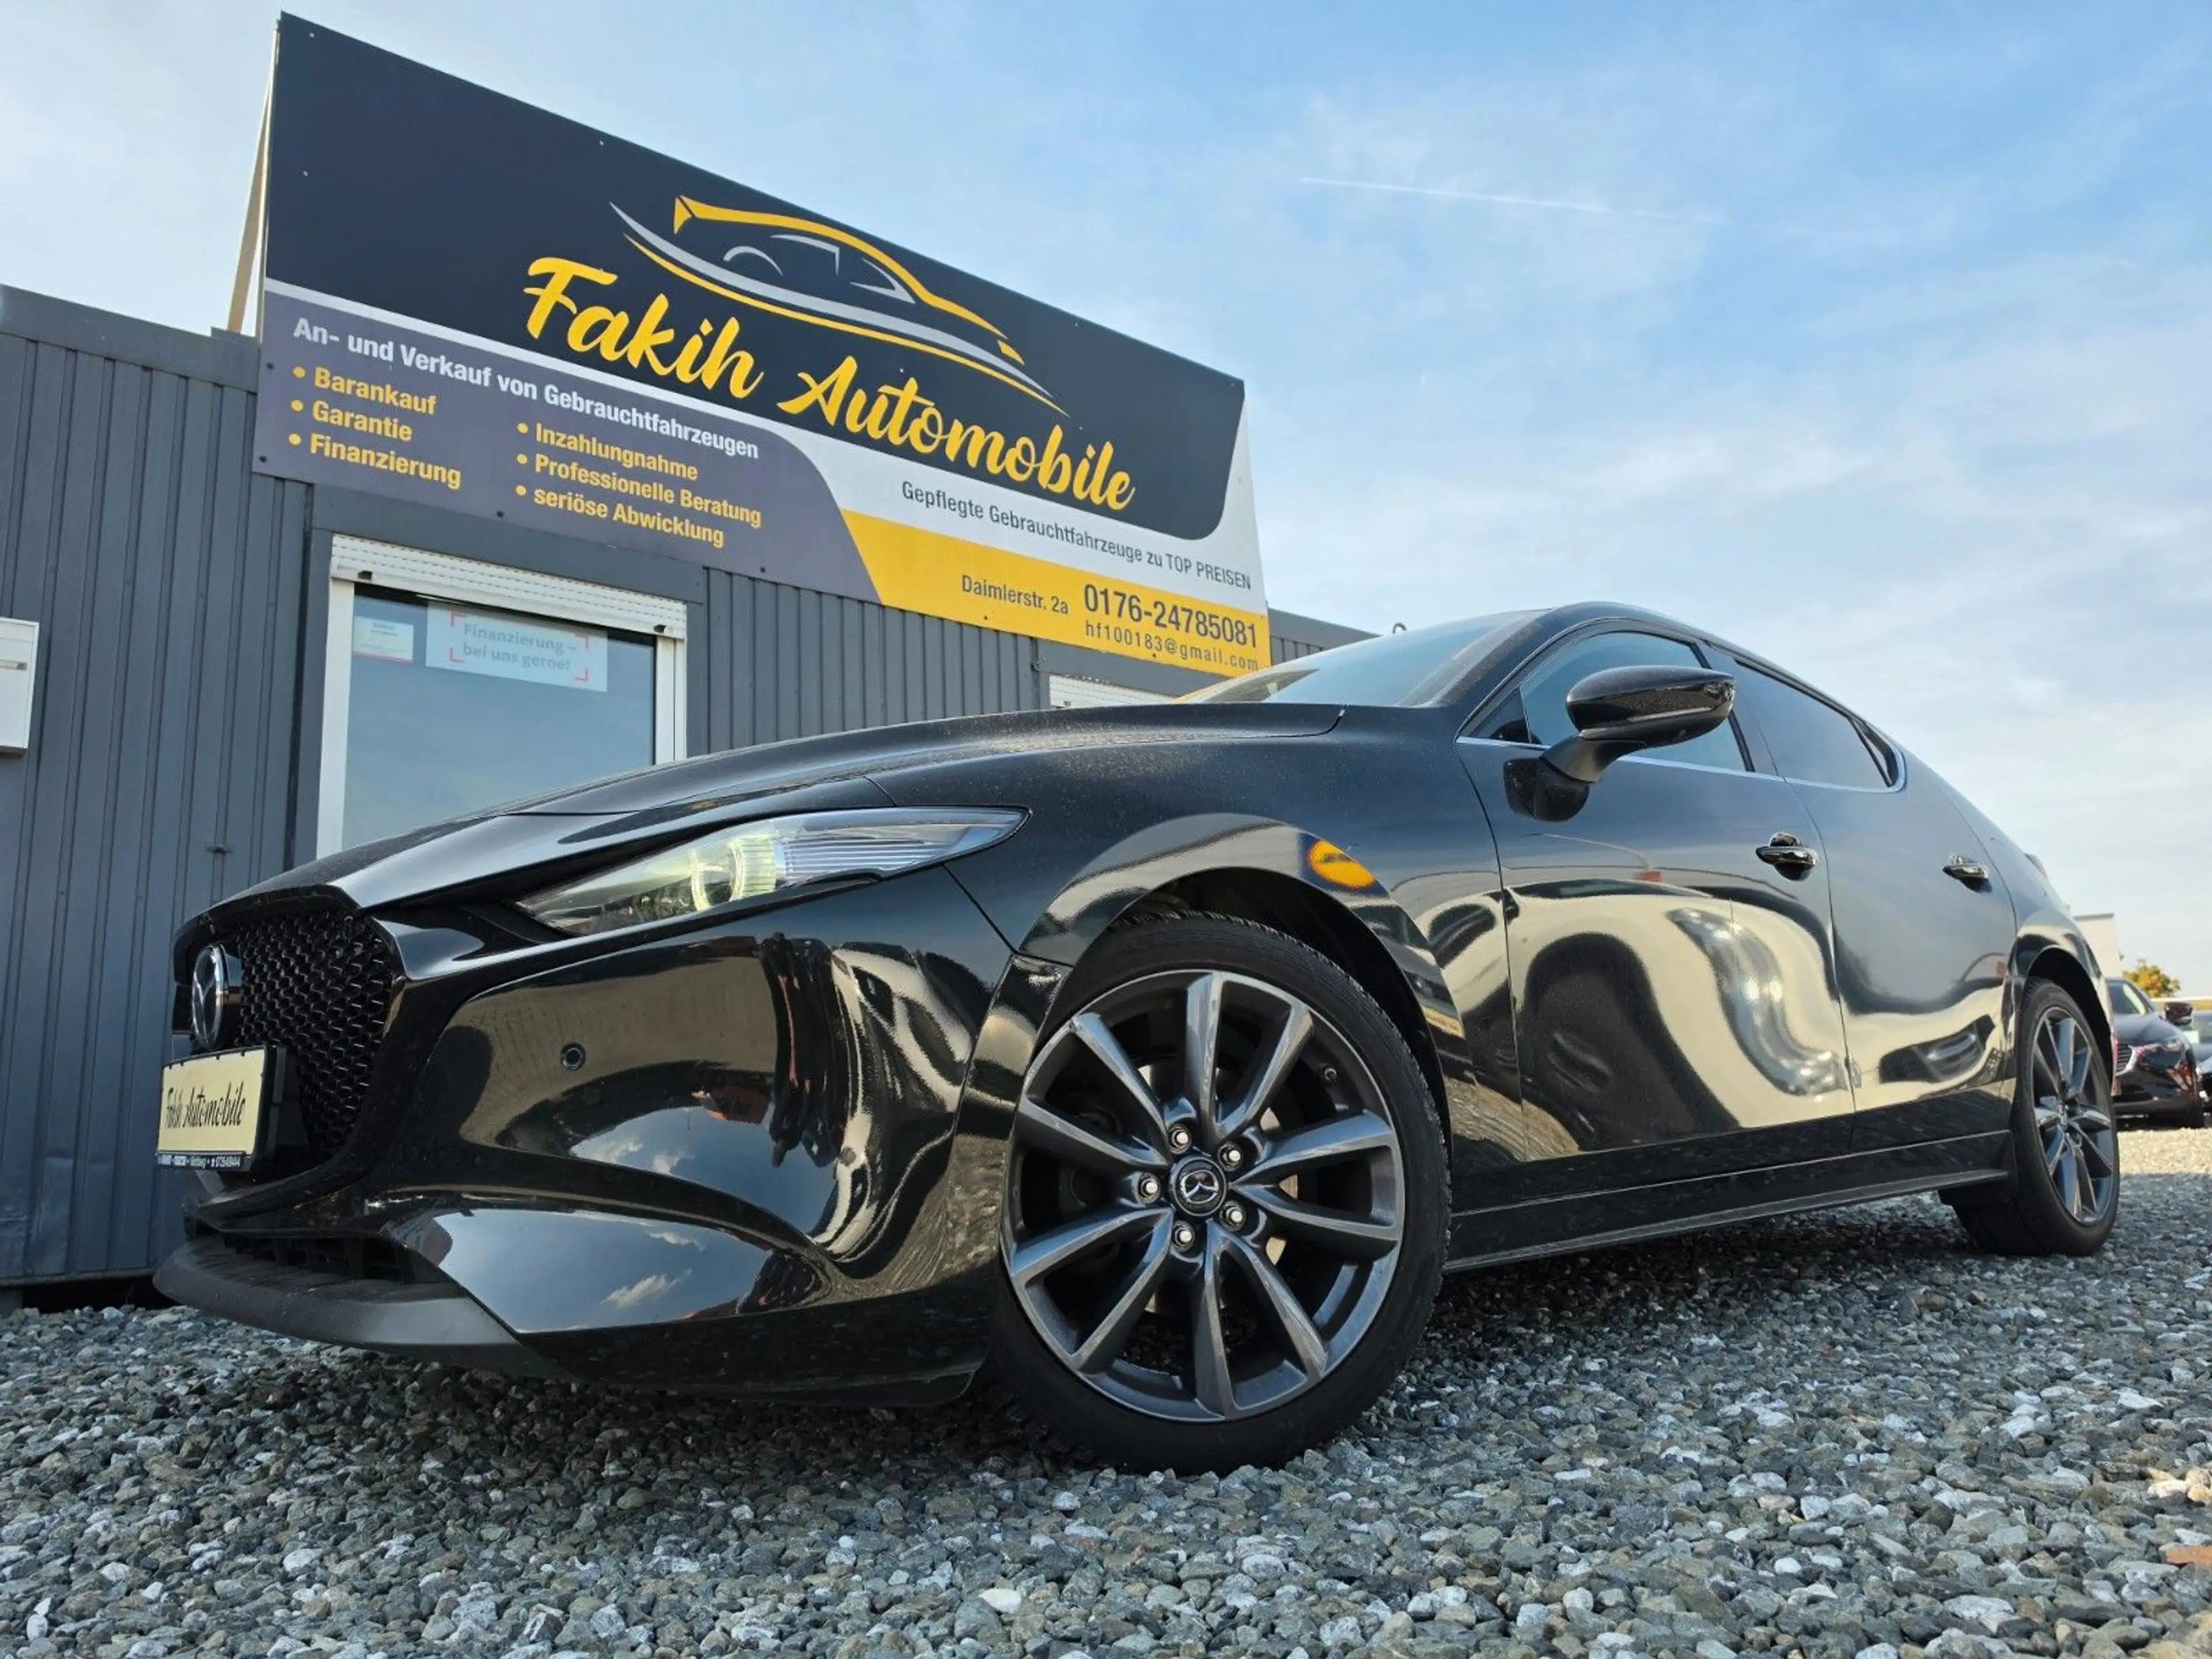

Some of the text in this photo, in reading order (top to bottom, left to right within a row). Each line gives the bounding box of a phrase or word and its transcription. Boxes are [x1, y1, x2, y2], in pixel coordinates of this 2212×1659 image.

[293, 317, 759, 459] An- und Verkauf von Gebrauchtfahrzeugen
[315, 367, 436, 415] Barankauf
[524, 256, 1135, 510] Fakih Automobile
[313, 401, 412, 441] Garantie
[310, 433, 461, 490] Finanzierung
[536, 423, 698, 480] Inzahlungnahme
[533, 486, 724, 548] seriöse Abwicklung
[535, 454, 762, 528] Professionelle Beratung
[902, 481, 1251, 590] Gepflegte Gebrauchtfahrzeuge zu TOP PREISEN
[961, 575, 1069, 615] Daimlerstr. 2a
[1084, 584, 1257, 647] 0176-24785081
[464, 623, 564, 655] Finanzierung
[464, 641, 486, 658] bei
[492, 649, 518, 663] uns
[1085, 620, 1259, 671] hf100183@gmail.com
